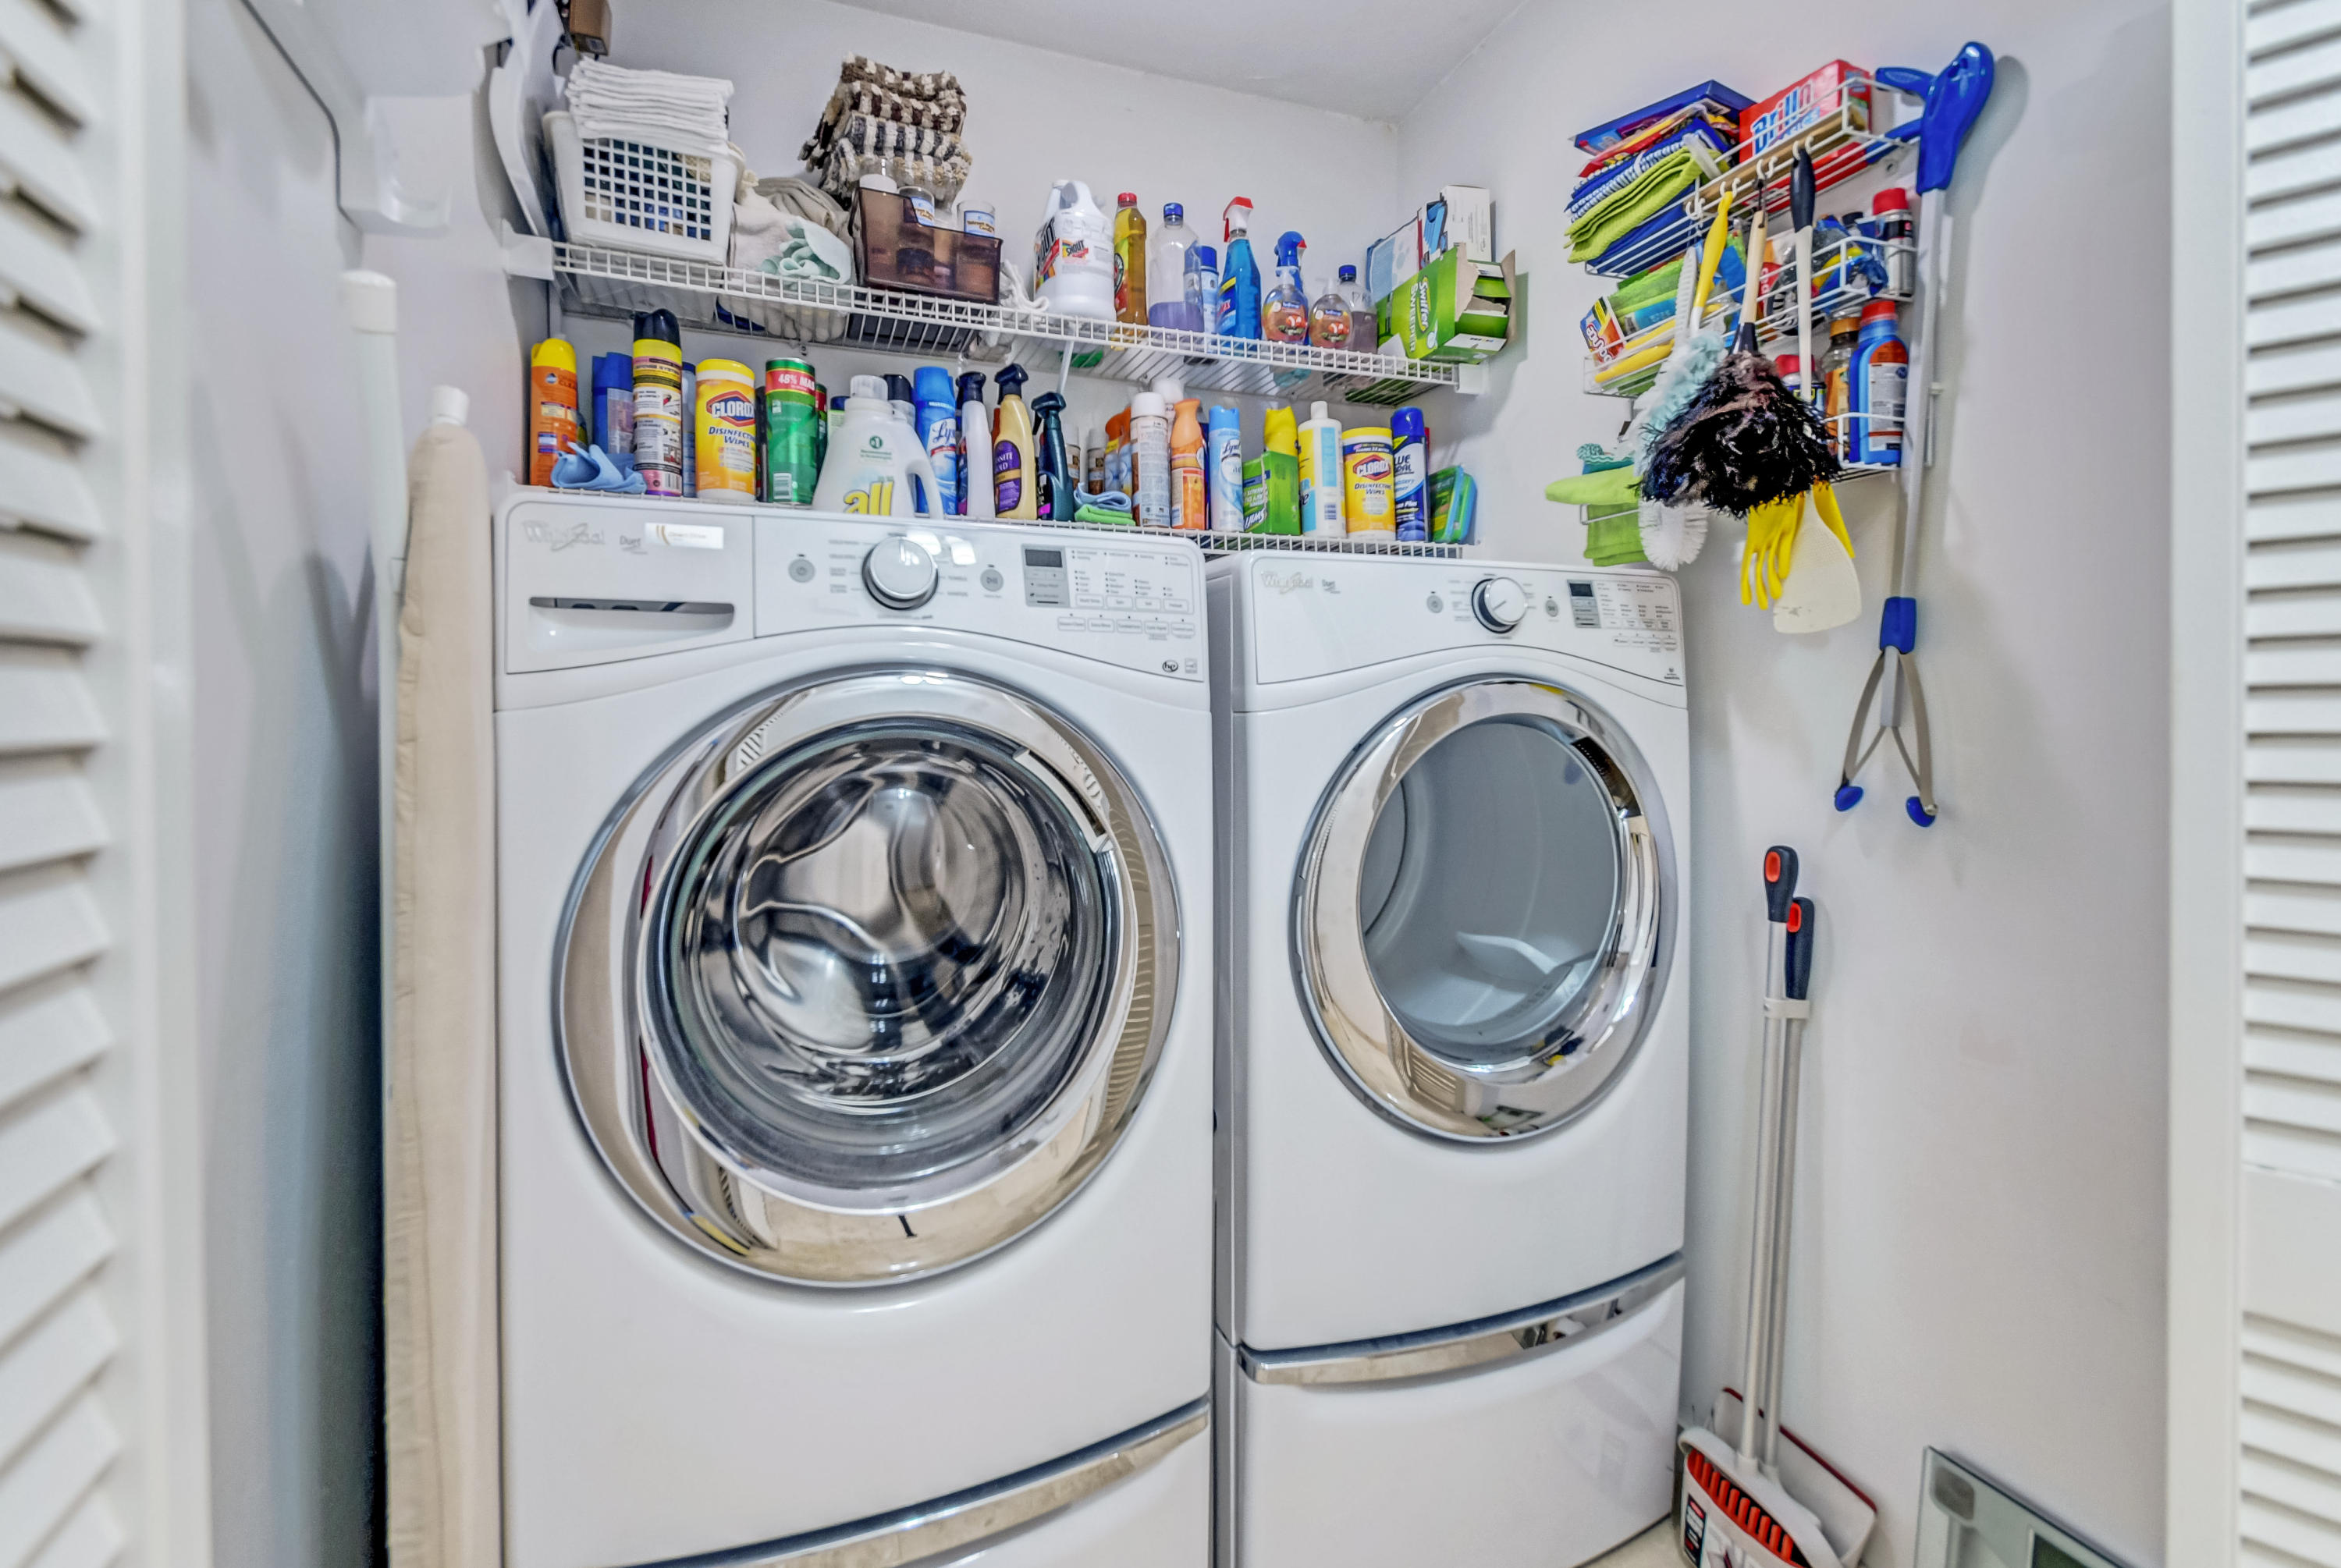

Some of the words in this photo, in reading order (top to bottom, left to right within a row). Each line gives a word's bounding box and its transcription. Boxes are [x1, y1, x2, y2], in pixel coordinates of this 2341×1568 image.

[1409, 282, 1419, 353] SWEEPER
[1419, 281, 1430, 328] Swiffer
[708, 426, 755, 442] DISINFECTI
[1357, 460, 1391, 477] CLOROX
[843, 481, 894, 516] all
